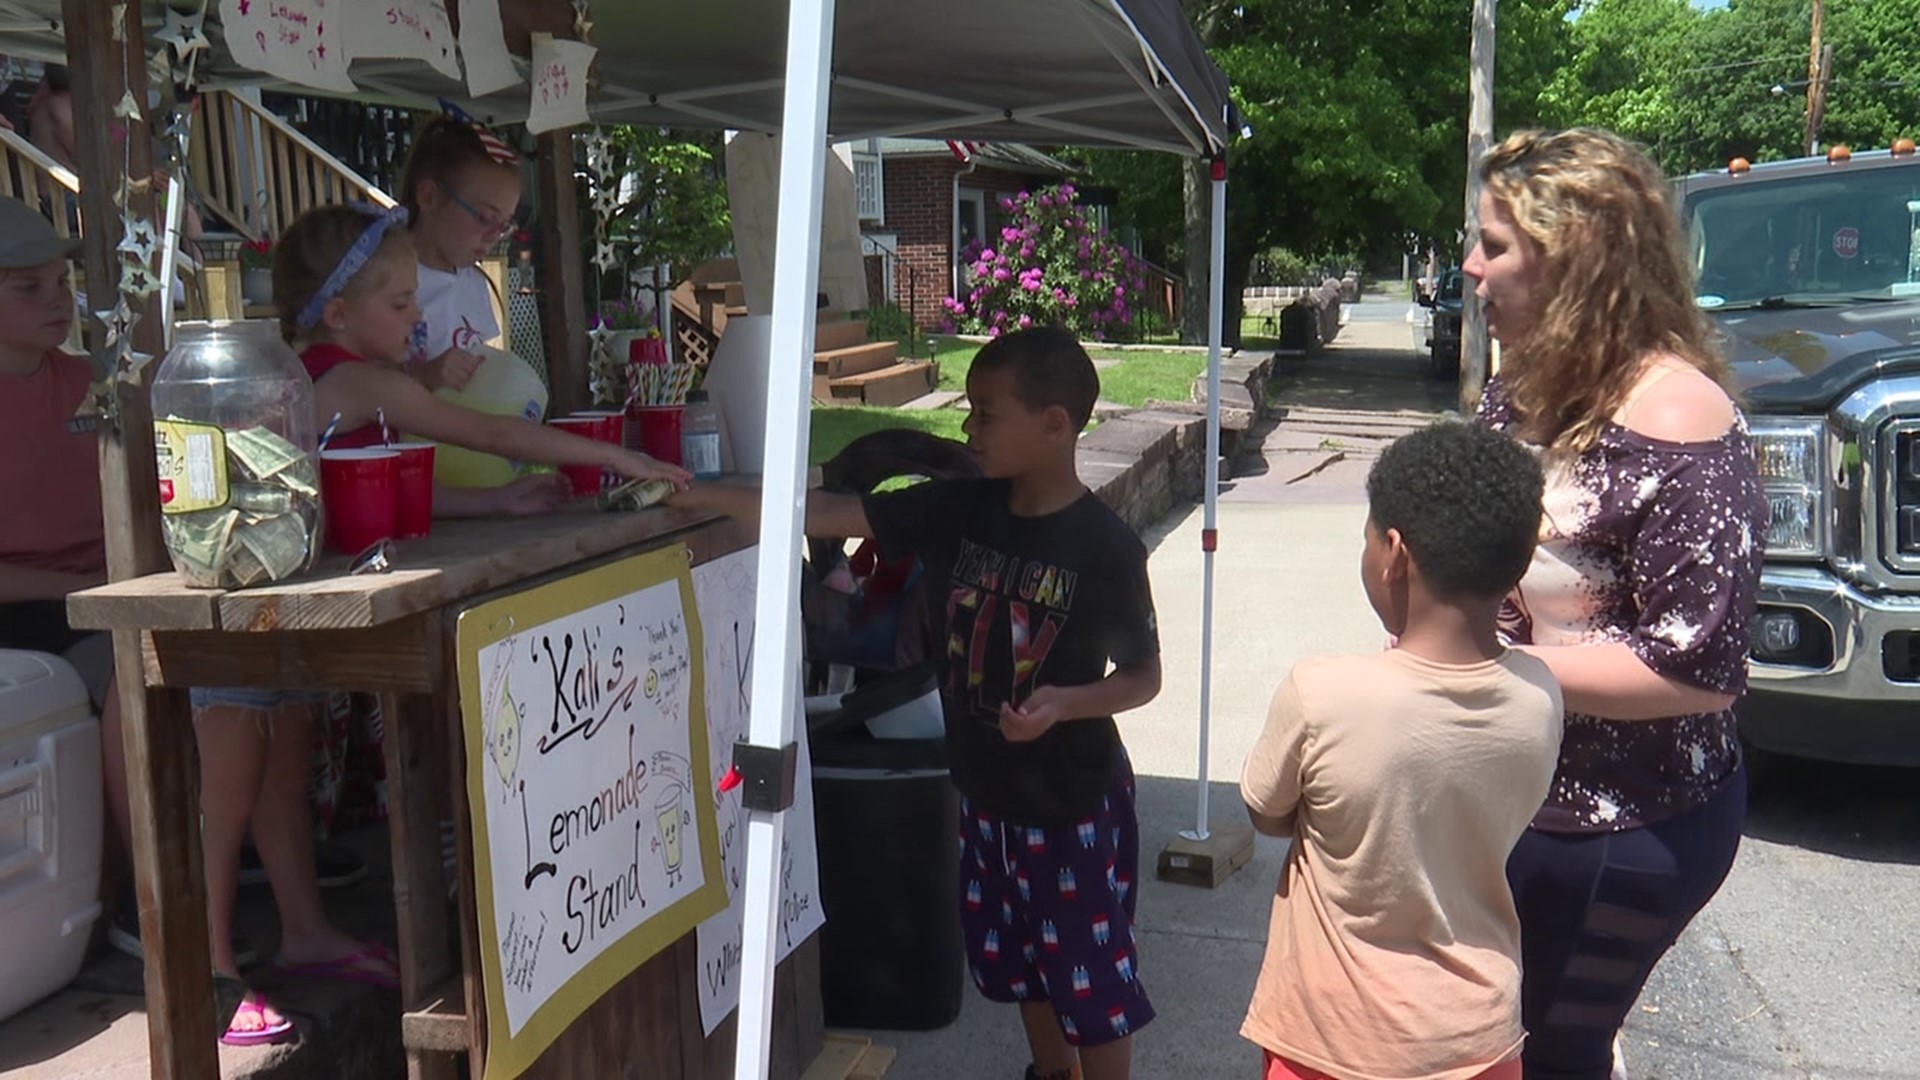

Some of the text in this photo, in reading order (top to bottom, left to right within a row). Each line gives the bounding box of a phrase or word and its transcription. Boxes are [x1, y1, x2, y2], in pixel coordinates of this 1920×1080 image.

[1003, 556, 1020, 595] I
[1018, 560, 1079, 612] CAN
[524, 723, 649, 891] Lemonade
[562, 819, 647, 954] Stand
